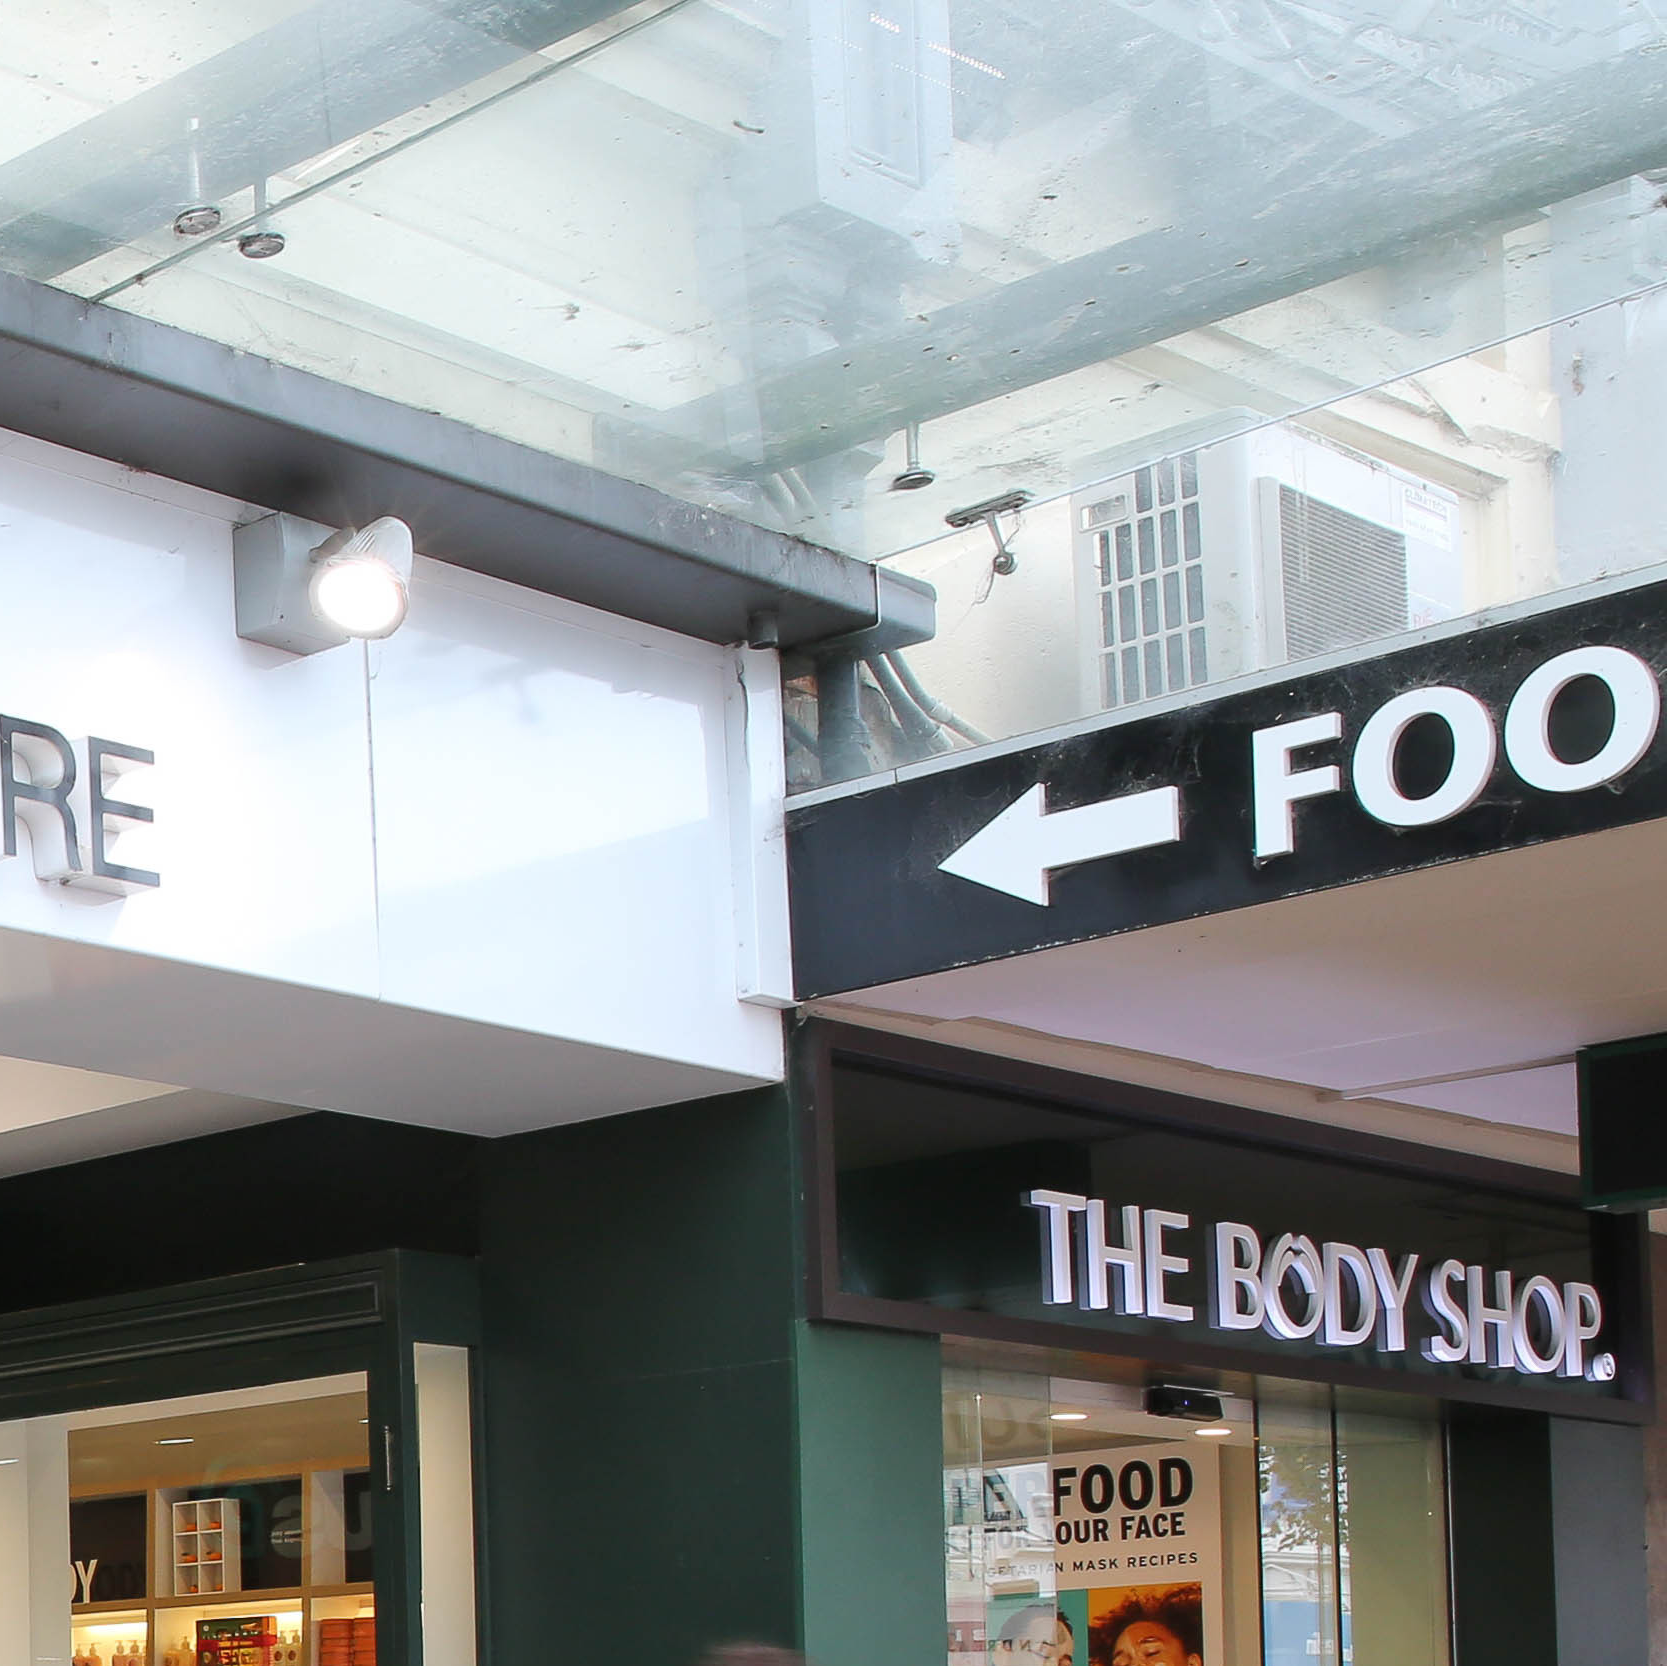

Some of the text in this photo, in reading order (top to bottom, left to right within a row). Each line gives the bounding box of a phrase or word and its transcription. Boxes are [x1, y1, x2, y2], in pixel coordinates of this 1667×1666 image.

[1027, 1187, 1195, 1323] THE
[1210, 1220, 1417, 1354] BODY
[1055, 1518, 1109, 1545] OUR
[1120, 1511, 1186, 1541] FACE
[1072, 1557, 1120, 1572] MASK
[1126, 1552, 1199, 1568] RECIPES
